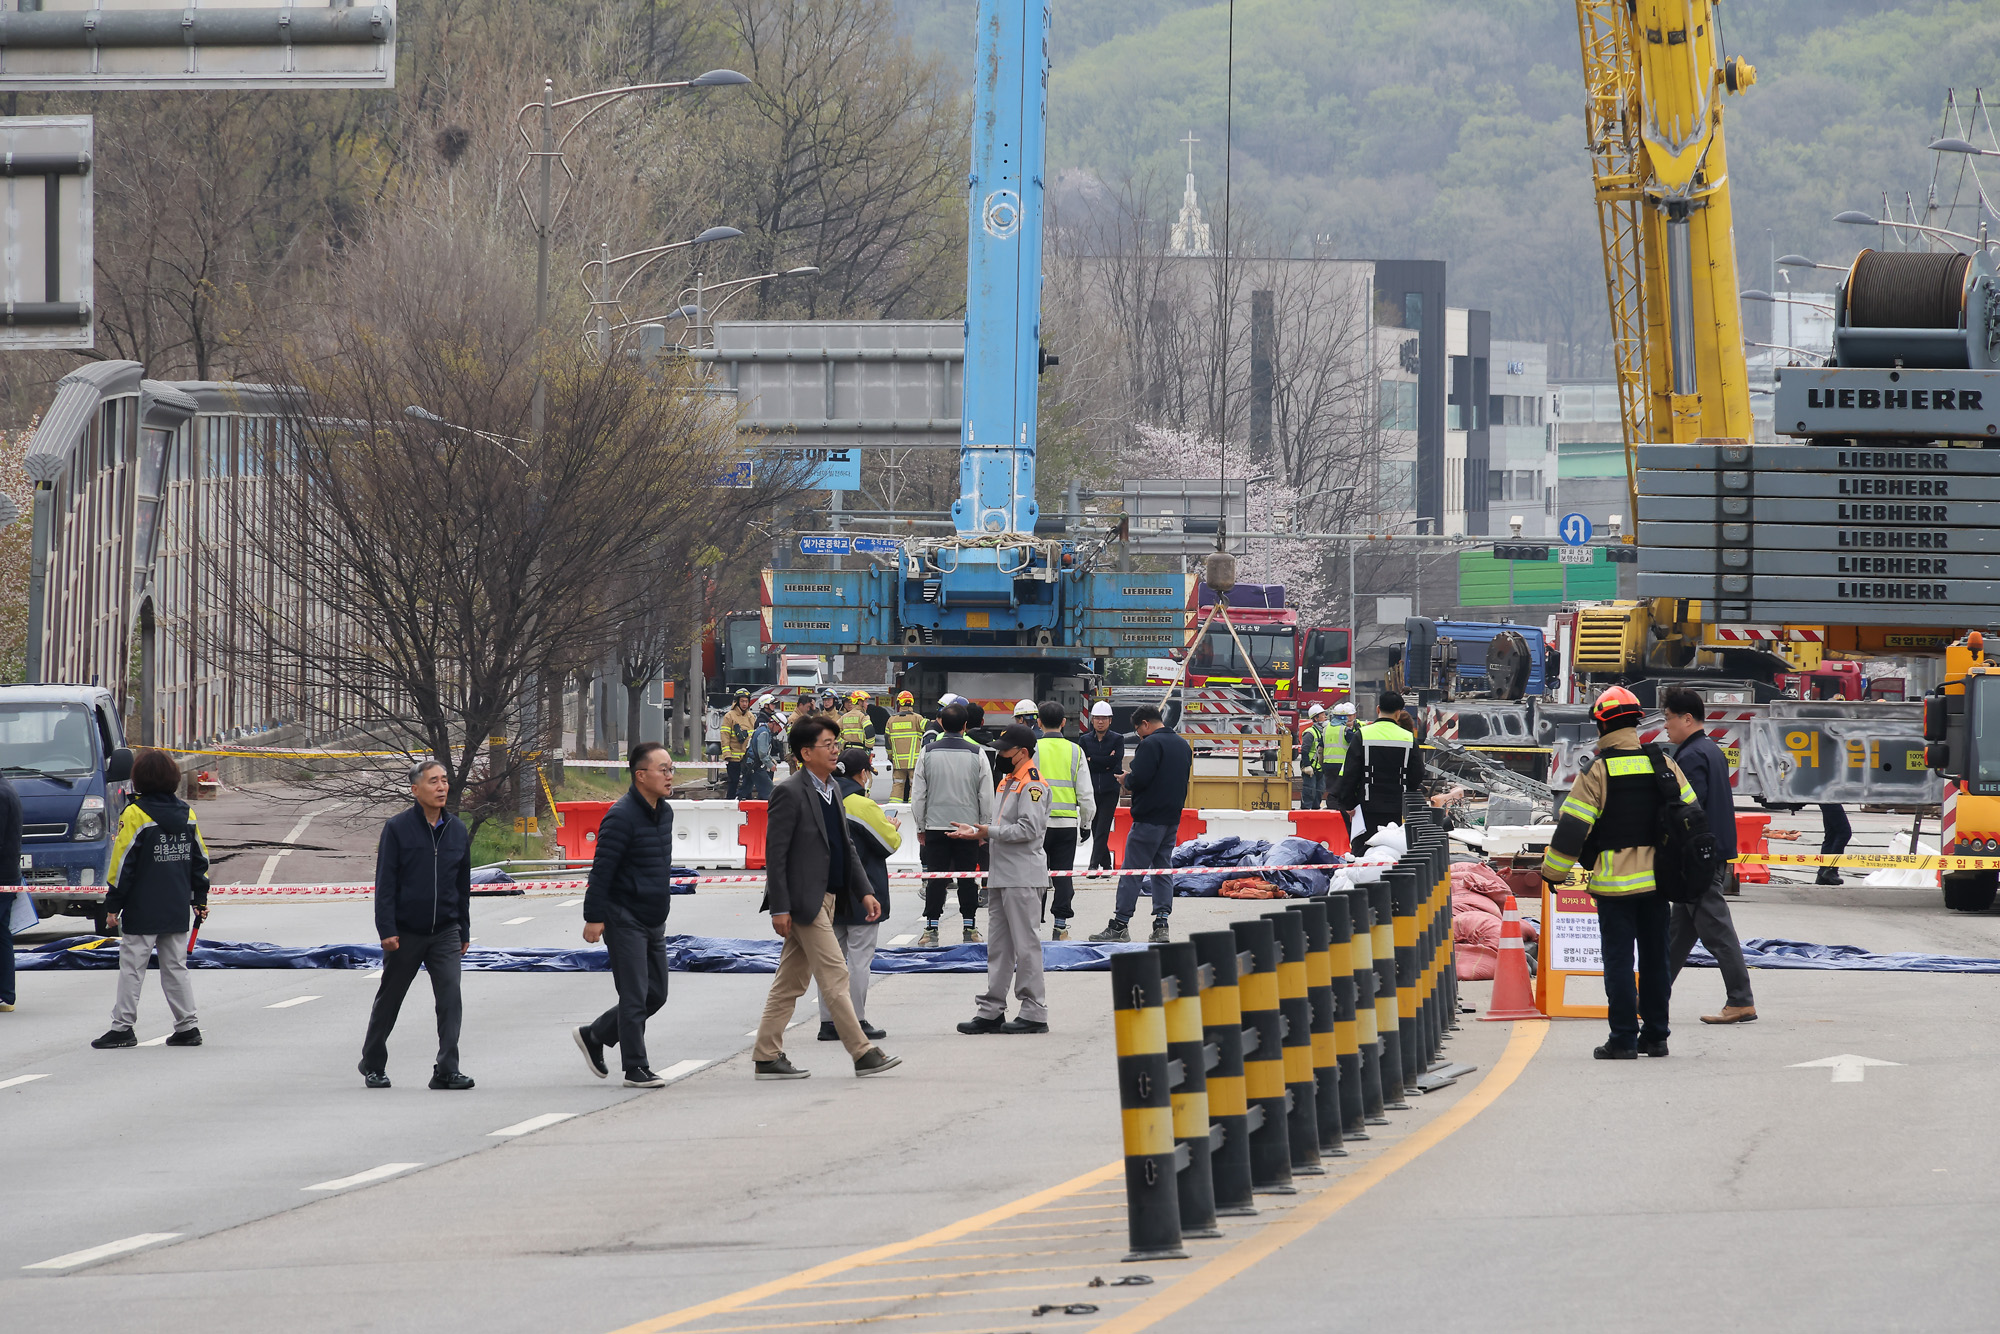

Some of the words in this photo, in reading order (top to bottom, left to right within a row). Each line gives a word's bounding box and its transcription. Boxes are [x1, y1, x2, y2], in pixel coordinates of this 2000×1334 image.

[1808, 388, 1984, 410] LIEBHERR
[1838, 451, 1948, 469] LIEBHERR
[1839, 478, 1948, 496] LIEBHERR
[1838, 504, 1948, 521] LIEBHERR
[803, 540, 848, 549] 빛가온중학교
[1838, 531, 1948, 548] LIEBHERR
[1838, 556, 1948, 574] LIEBHERR
[1838, 582, 1948, 600] LIEBHERR
[1272, 662, 1290, 670] 구조
[1252, 802, 1280, 810] 안전제일
[160, 832, 186, 842] 경기도
[154, 842, 191, 855] 의용소방대
